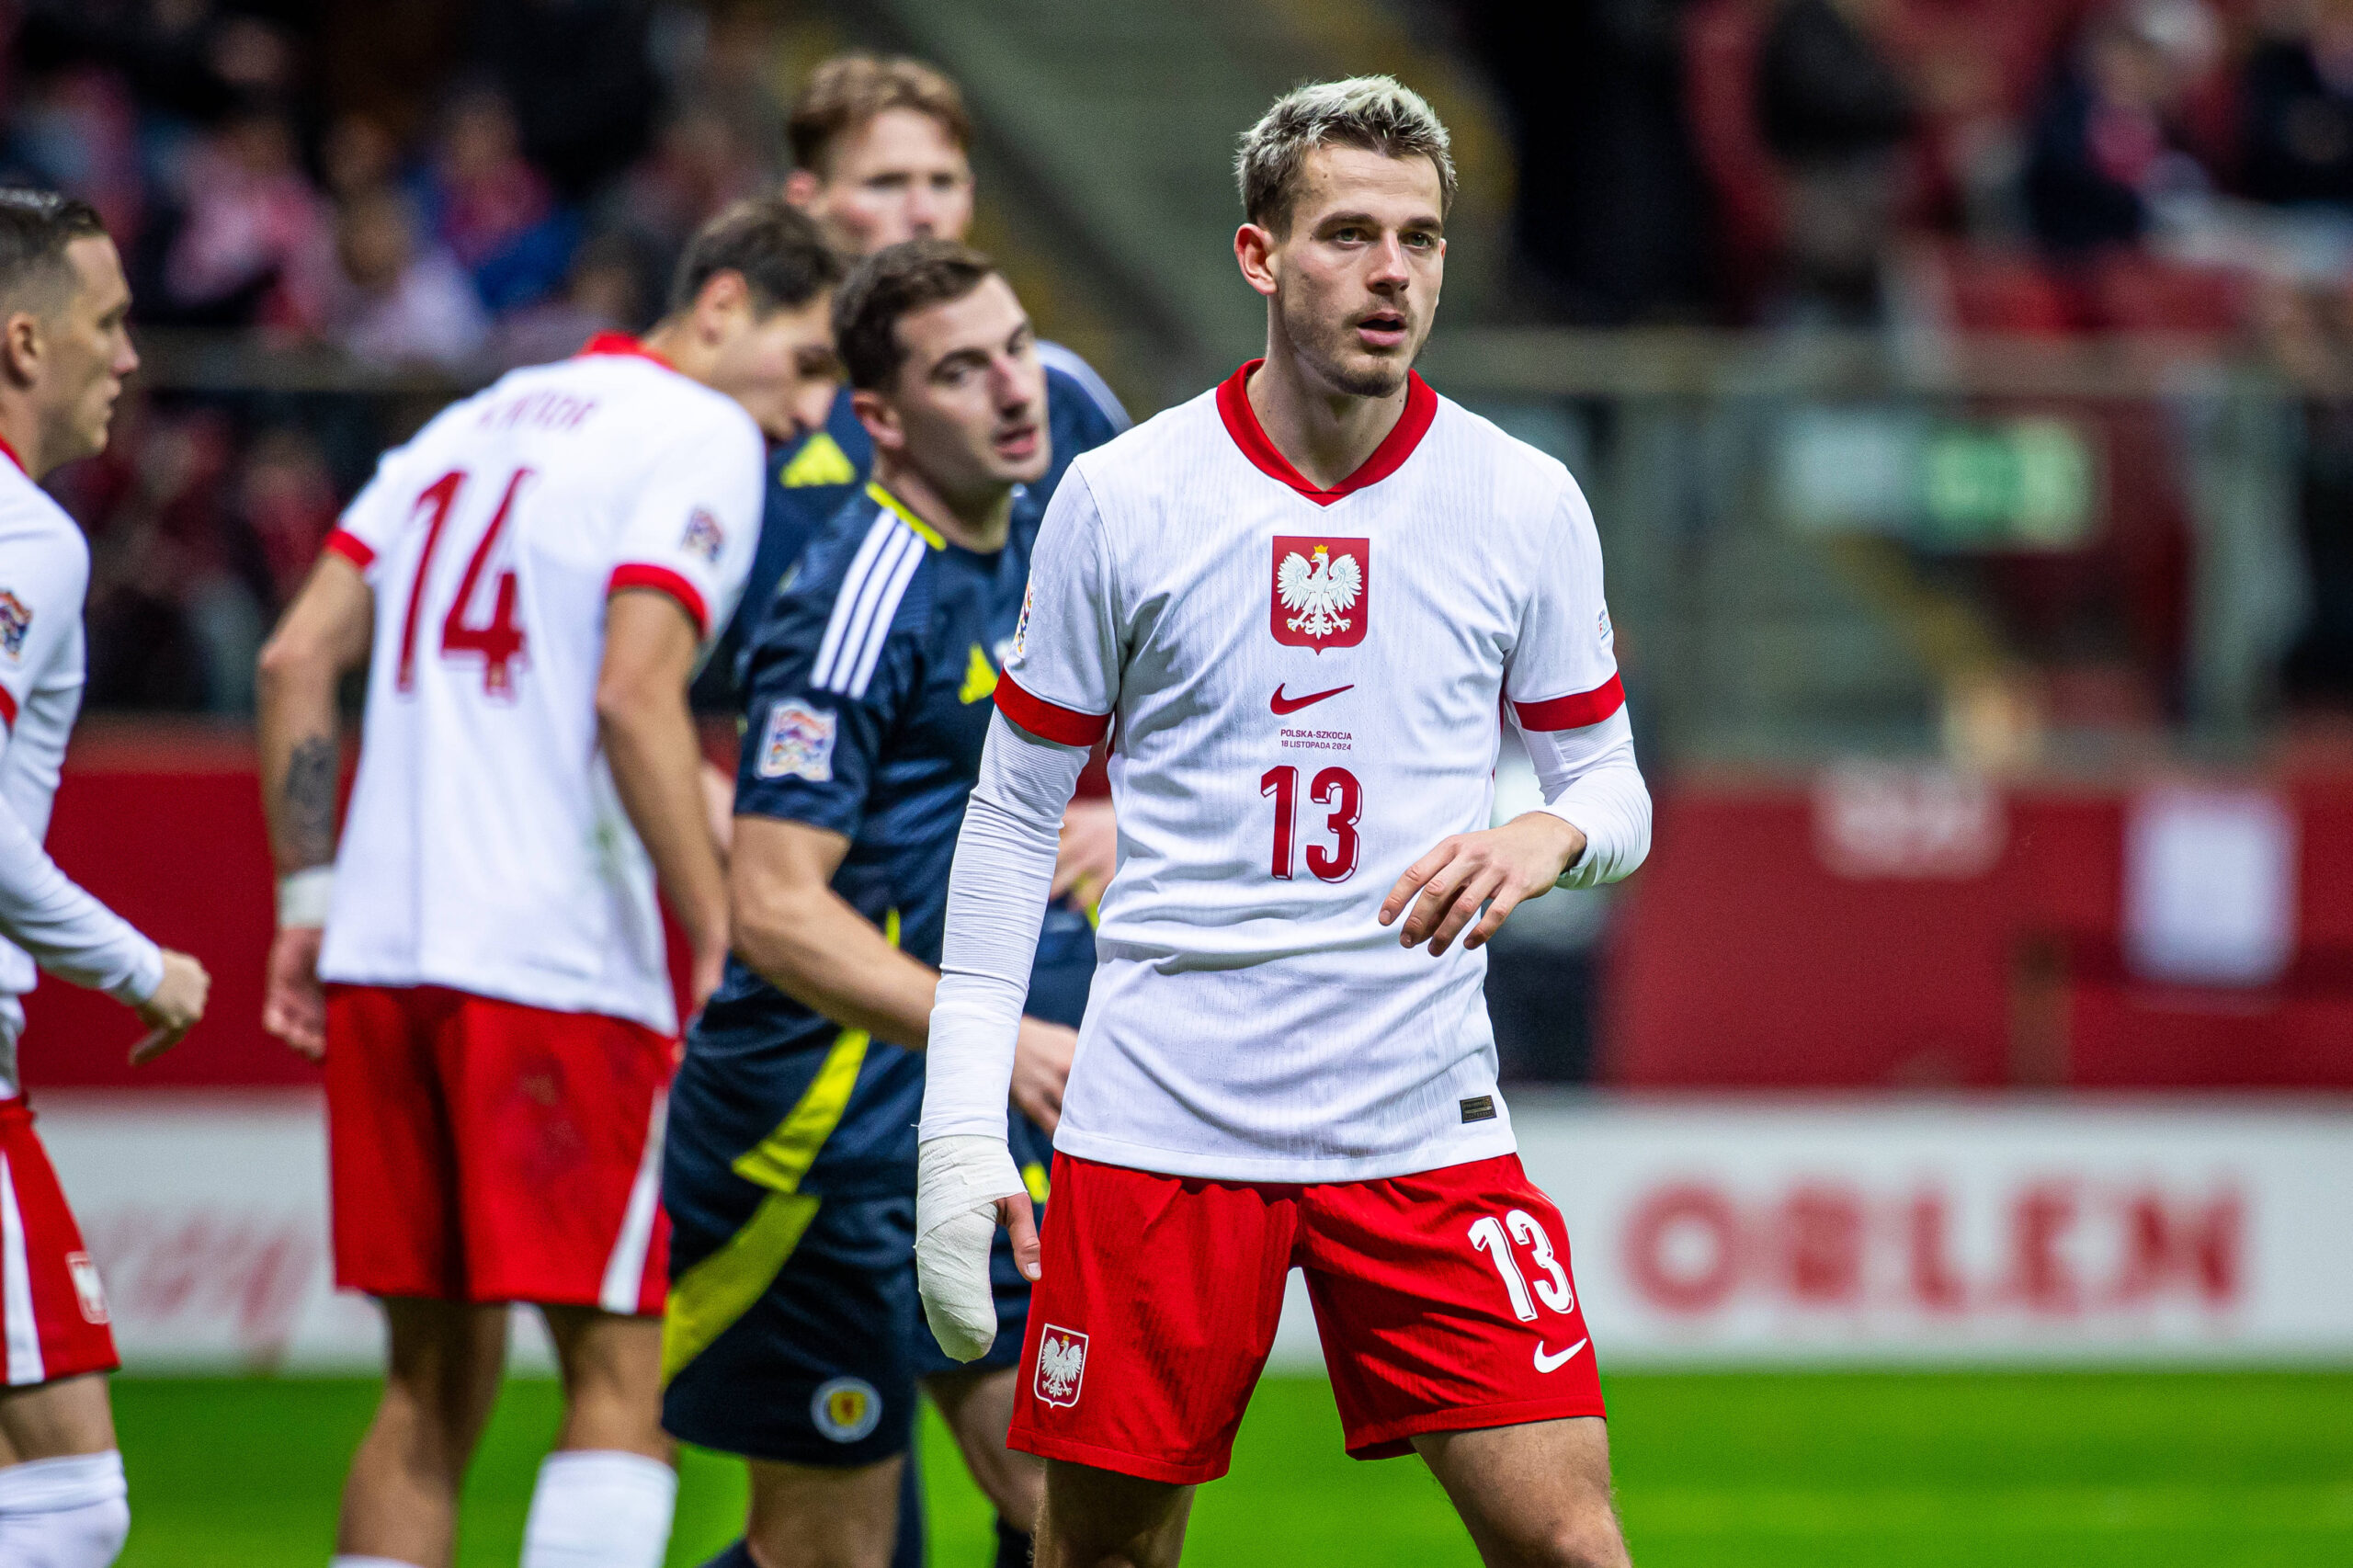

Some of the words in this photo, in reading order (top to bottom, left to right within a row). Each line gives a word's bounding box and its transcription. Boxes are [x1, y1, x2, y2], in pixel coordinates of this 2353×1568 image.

[396, 468, 532, 699] 14
[1280, 729, 1352, 740] POLSKA-SZKOCJA
[1290, 740, 1330, 750] LISTOPADA
[1332, 742, 1351, 751] 2024
[1260, 766, 1363, 884] 13
[1467, 1209, 1574, 1322] 13
